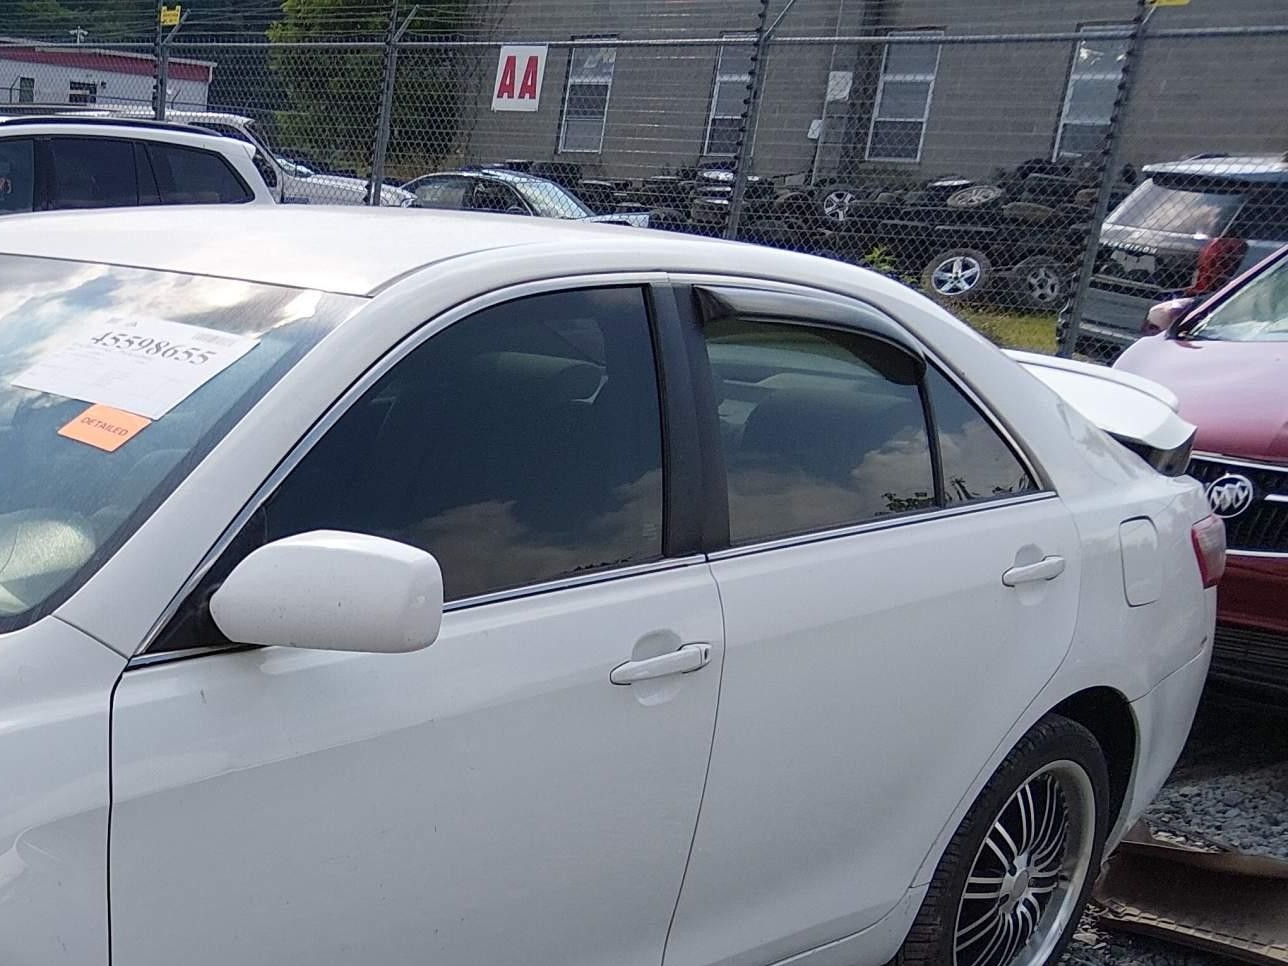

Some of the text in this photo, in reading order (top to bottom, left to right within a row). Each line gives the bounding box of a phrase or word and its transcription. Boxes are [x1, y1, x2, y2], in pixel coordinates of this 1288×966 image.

[496, 55, 539, 99] AA
[90, 331, 217, 366] 45598655
[80, 416, 129, 437] DETAILED
